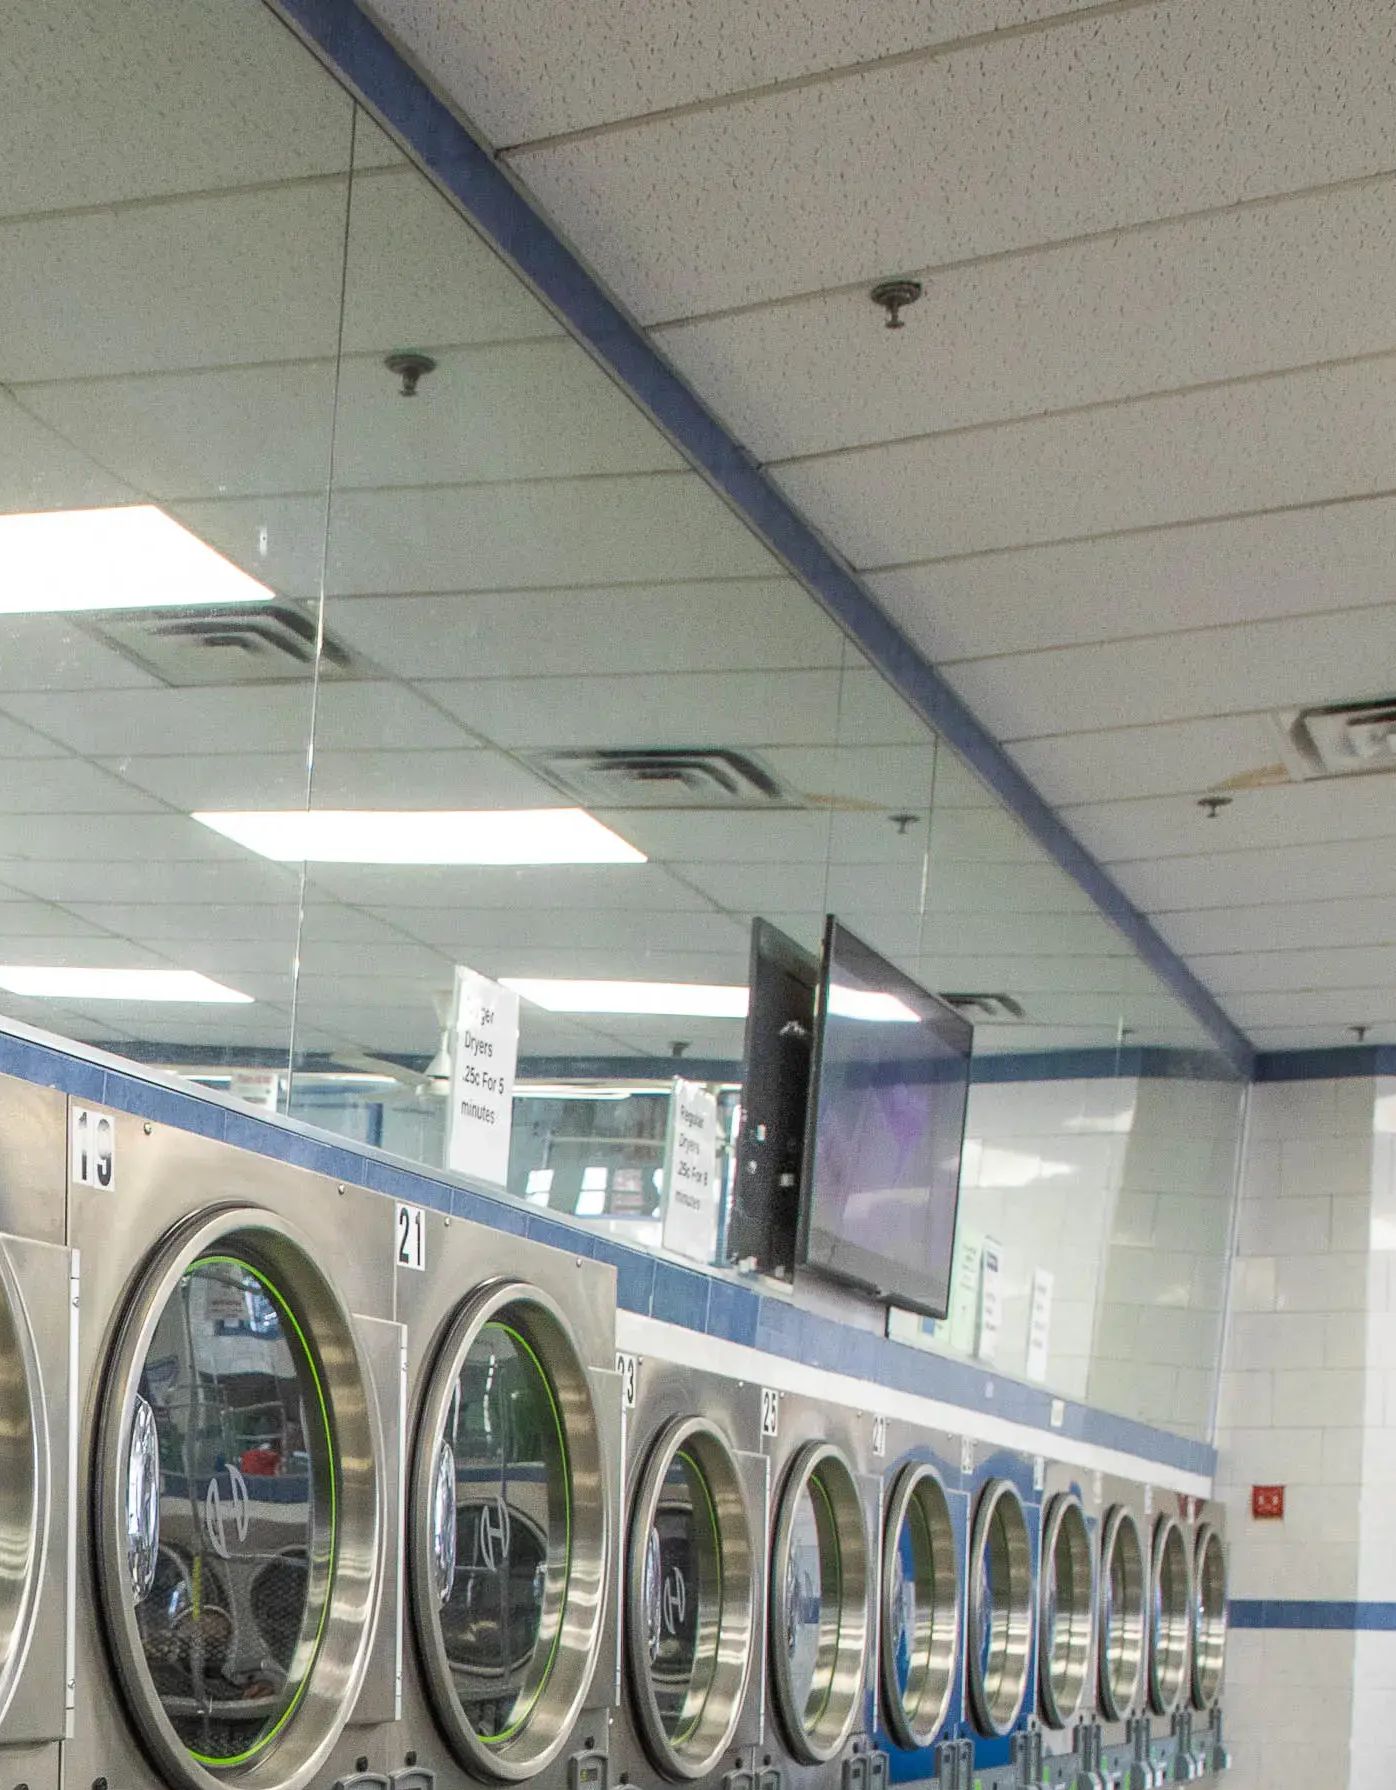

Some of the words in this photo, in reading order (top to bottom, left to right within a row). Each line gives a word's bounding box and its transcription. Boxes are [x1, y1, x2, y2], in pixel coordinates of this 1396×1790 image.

[464, 1030, 493, 1058] Dryers
[482, 1071, 496, 1092] For
[498, 1077, 505, 1095] 5
[461, 1099, 495, 1124] minutes
[399, 1207, 420, 1265] 21
[764, 1391, 776, 1433] 25
